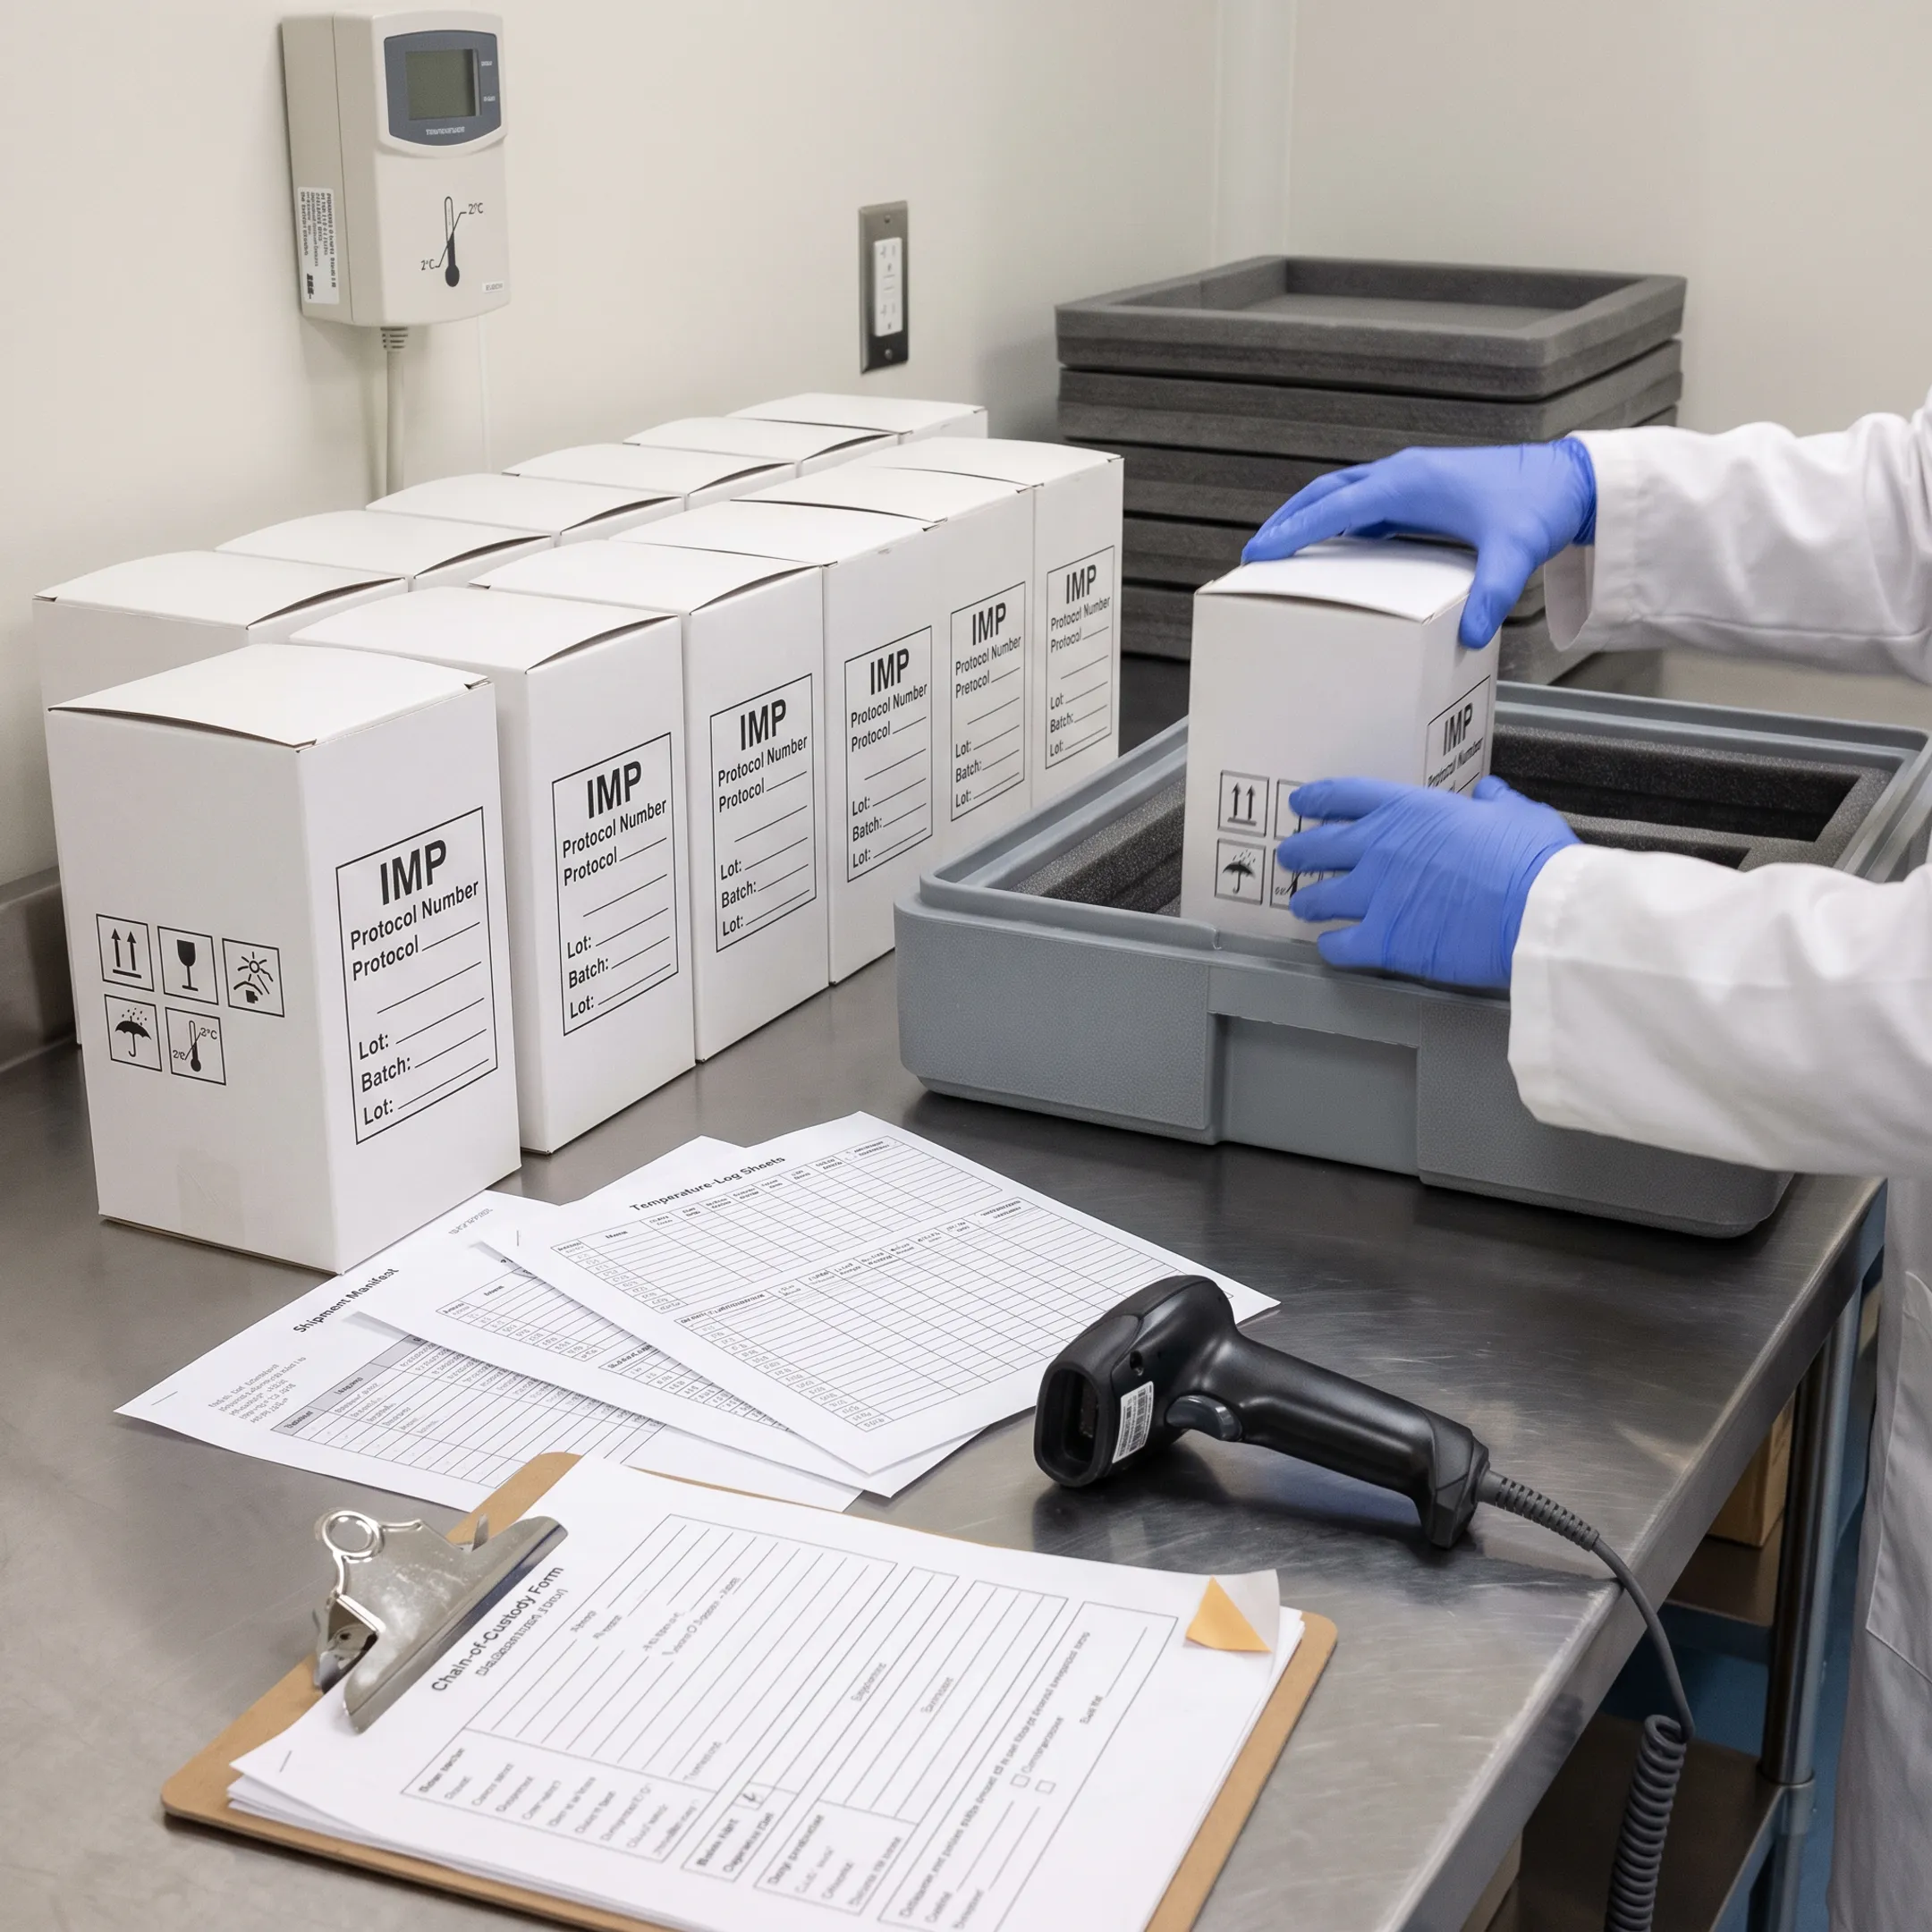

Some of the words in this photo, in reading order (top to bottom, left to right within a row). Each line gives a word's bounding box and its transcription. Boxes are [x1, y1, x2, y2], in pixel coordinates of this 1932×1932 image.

[1066, 564, 1097, 604] IMP
[1083, 597, 1110, 617] Number
[972, 602, 1007, 646] IMP
[992, 635, 1021, 660] Number
[870, 648, 910, 695] IMP
[851, 697, 891, 728] Protocol
[893, 683, 928, 710] Number
[740, 699, 787, 750] IMP
[851, 721, 891, 753] Protocol
[1443, 702, 1473, 757] IMP
[718, 752, 764, 787] Protocol
[767, 736, 808, 766] Number
[955, 741, 971, 758] Lot:
[955, 759, 982, 784] Batch:
[587, 760, 641, 819] IMP
[718, 778, 765, 813] Protocol
[955, 790, 971, 809] Lot:
[852, 797, 870, 816] Lot:
[562, 818, 616, 858] Protocol
[620, 799, 666, 833] Number
[852, 816, 882, 842] Batch:
[379, 840, 447, 906] IMP
[564, 846, 617, 886] Protocol
[720, 860, 741, 881] Lot:
[852, 849, 871, 869] Lot:
[721, 880, 757, 909] Batch:
[350, 905, 417, 950] Protocol
[421, 881, 479, 919] Number
[722, 915, 744, 936] Lot:
[352, 935, 419, 981] Protocol
[567, 936, 591, 959] Lot:
[568, 957, 608, 989] Batch:
[570, 996, 594, 1019] Lot:
[359, 1034, 389, 1060] Lot:
[361, 1055, 411, 1092] Batch:
[363, 1099, 394, 1126] Lot:
[292, 1299, 352, 1333] Shipment
